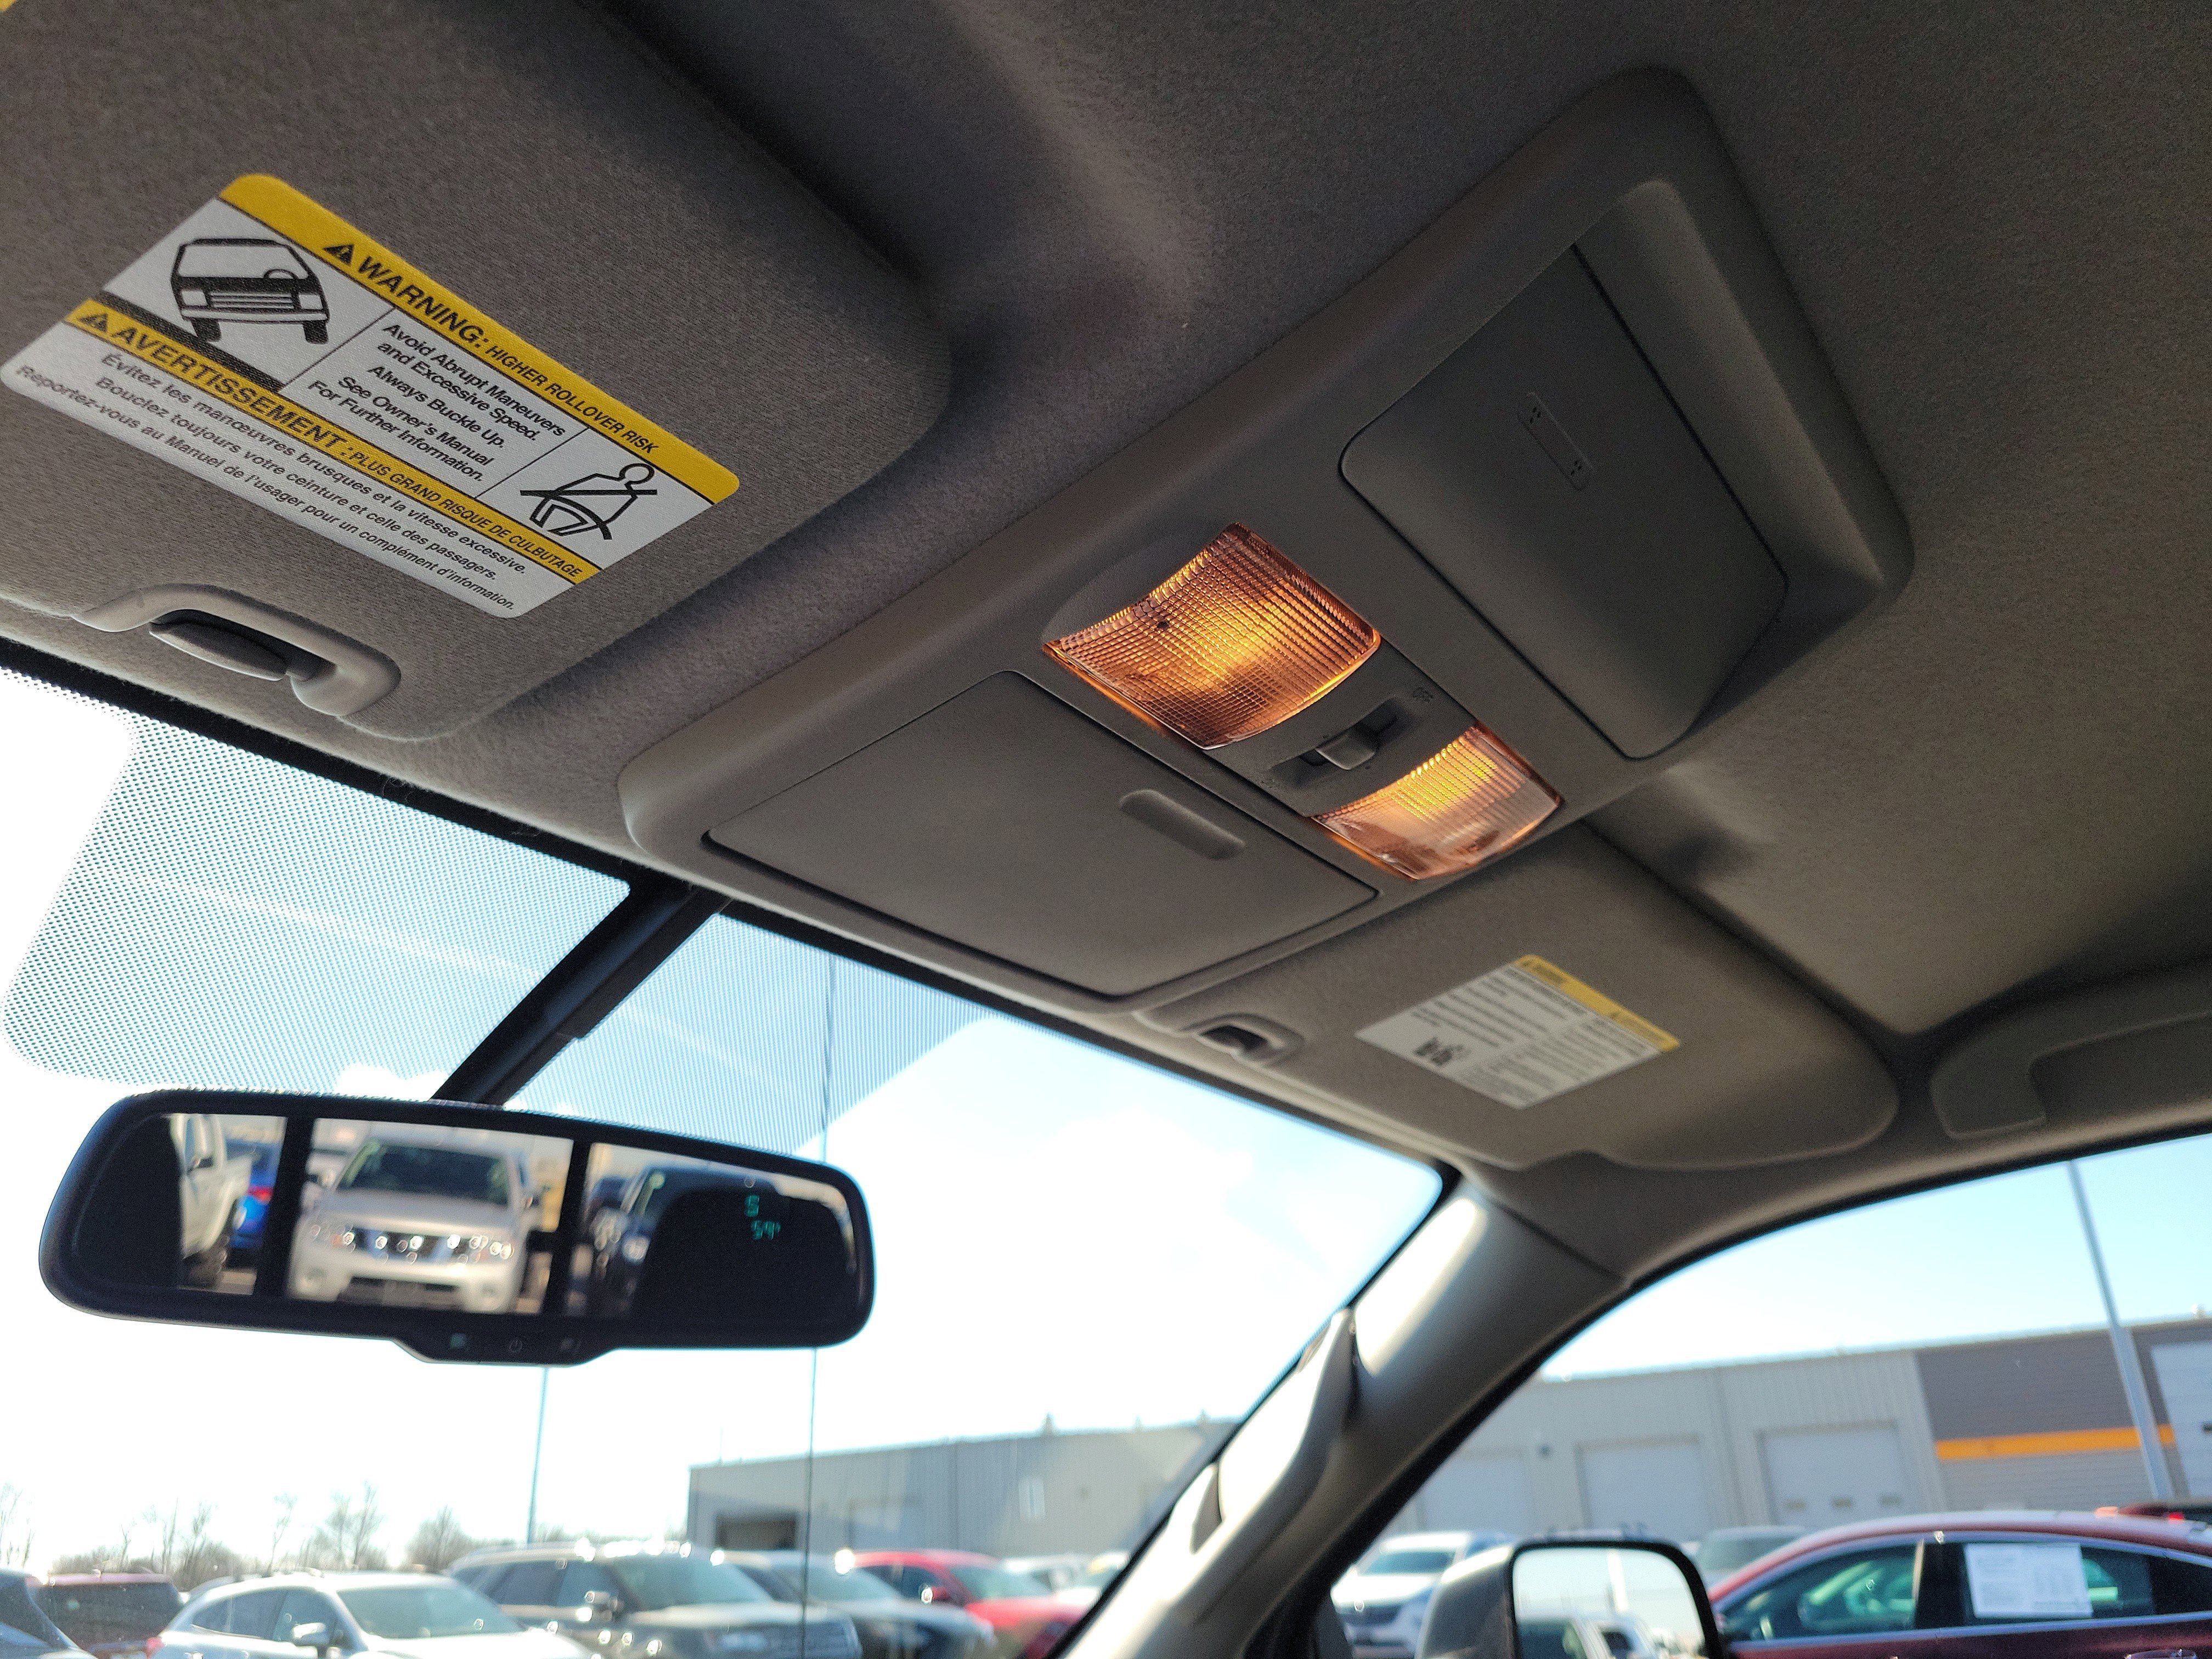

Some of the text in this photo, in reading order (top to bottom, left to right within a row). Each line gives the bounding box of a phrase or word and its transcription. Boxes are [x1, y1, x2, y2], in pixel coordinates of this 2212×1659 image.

[358, 256, 659, 454] WARNING: HIGHER ROLLOVER RISK
[366, 366, 505, 448] Always Buckle Up.
[377, 343, 540, 441] and Excessive Speed.
[382, 324, 566, 436] Avoid Abrupt Maneuvers
[17, 365, 140, 428] Reportez-vous
[140, 426, 165, 439] au
[165, 435, 227, 468] Manuel
[223, 466, 245, 478] de
[301, 505, 341, 523] pour
[338, 521, 359, 534] un
[358, 531, 439, 571] complément
[95, 377, 496, 580] Bouclez toujours votre ceinture et celle des passagers.
[101, 354, 526, 574] Évitez les manœuvres brusques et la vitesse excessive.
[307, 380, 483, 482] For Further Information.
[338, 376, 495, 466] See Owner's Manual
[348, 452, 391, 476] PLUS
[389, 473, 442, 502] GRAND
[438, 498, 493, 528] RISQUE
[488, 524, 512, 538] DE
[508, 535, 583, 577] CULBUTAGE
